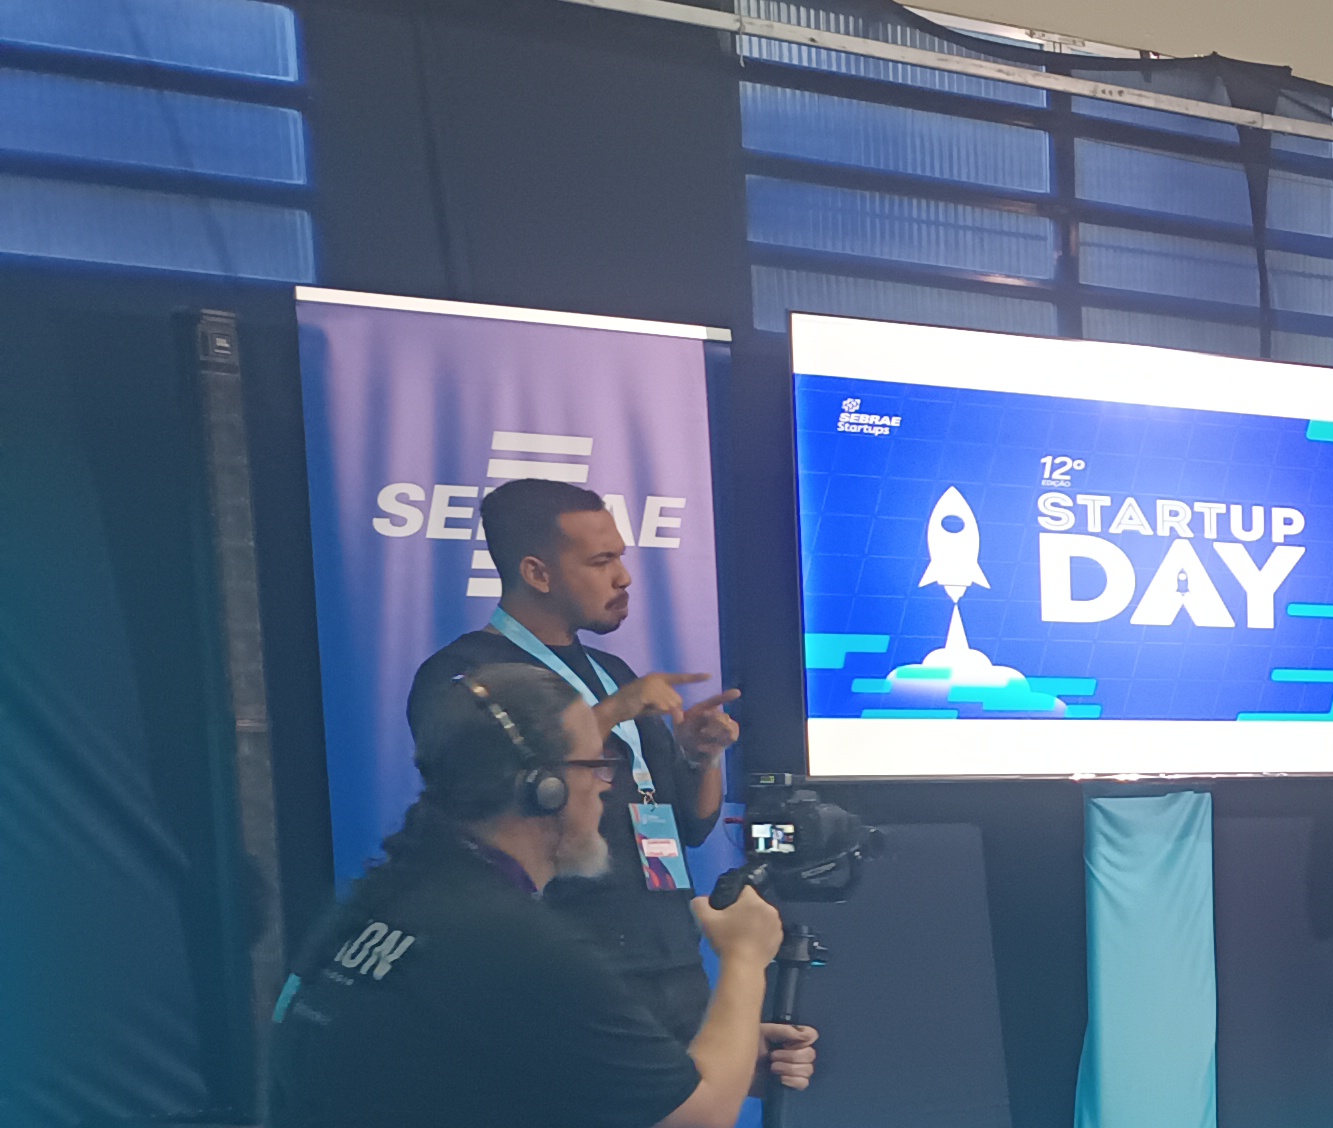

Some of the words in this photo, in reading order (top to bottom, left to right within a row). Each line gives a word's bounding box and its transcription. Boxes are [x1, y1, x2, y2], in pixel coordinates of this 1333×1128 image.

[837, 421, 890, 437] Startups
[839, 413, 902, 427] SEBRAE
[1041, 479, 1072, 488] EDIÇÃO
[372, 482, 687, 549] SEAE
[1037, 491, 1306, 544] STARTUP
[1039, 532, 1306, 629] DAY
